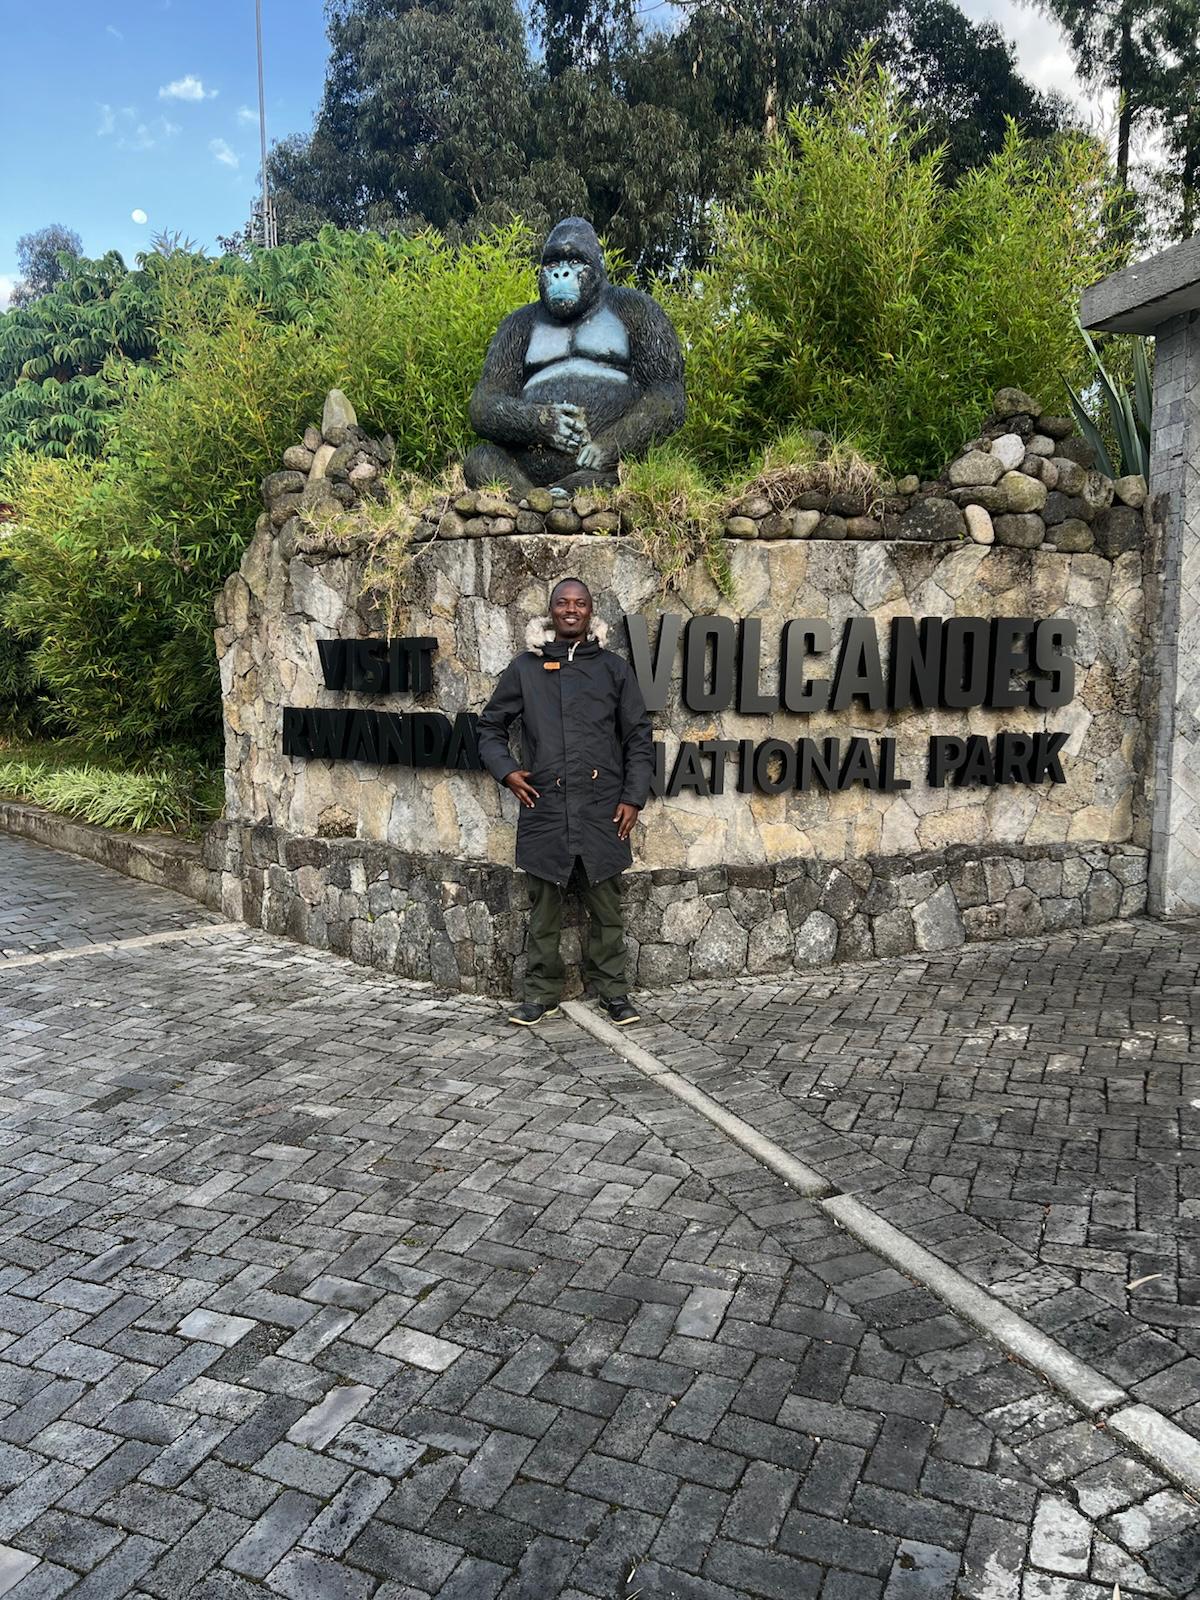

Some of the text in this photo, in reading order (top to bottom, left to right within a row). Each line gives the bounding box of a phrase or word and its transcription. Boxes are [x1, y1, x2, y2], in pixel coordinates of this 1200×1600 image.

[316, 637, 437, 693] VISIT
[623, 614, 1077, 713] VOLCANOES
[283, 707, 488, 769] RWANDA
[929, 732, 1071, 788] PARK
